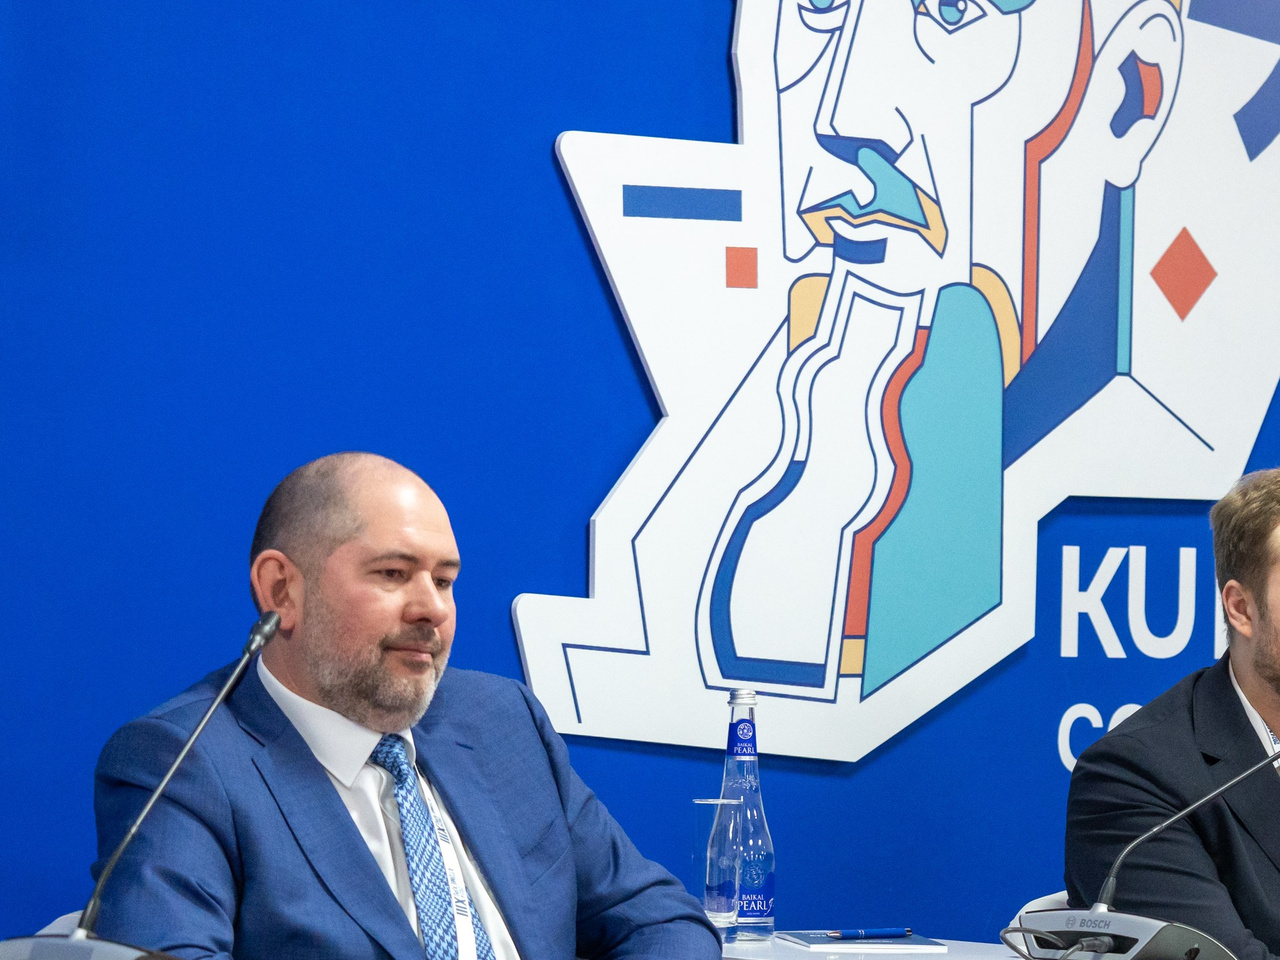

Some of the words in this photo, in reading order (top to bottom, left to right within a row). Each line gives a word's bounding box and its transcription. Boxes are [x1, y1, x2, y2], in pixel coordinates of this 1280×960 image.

[733, 746, 755, 754] PEARL
[455, 896, 469, 917] XIII
[738, 900, 768, 911] PEARL
[1079, 917, 1112, 930] BOSCH
